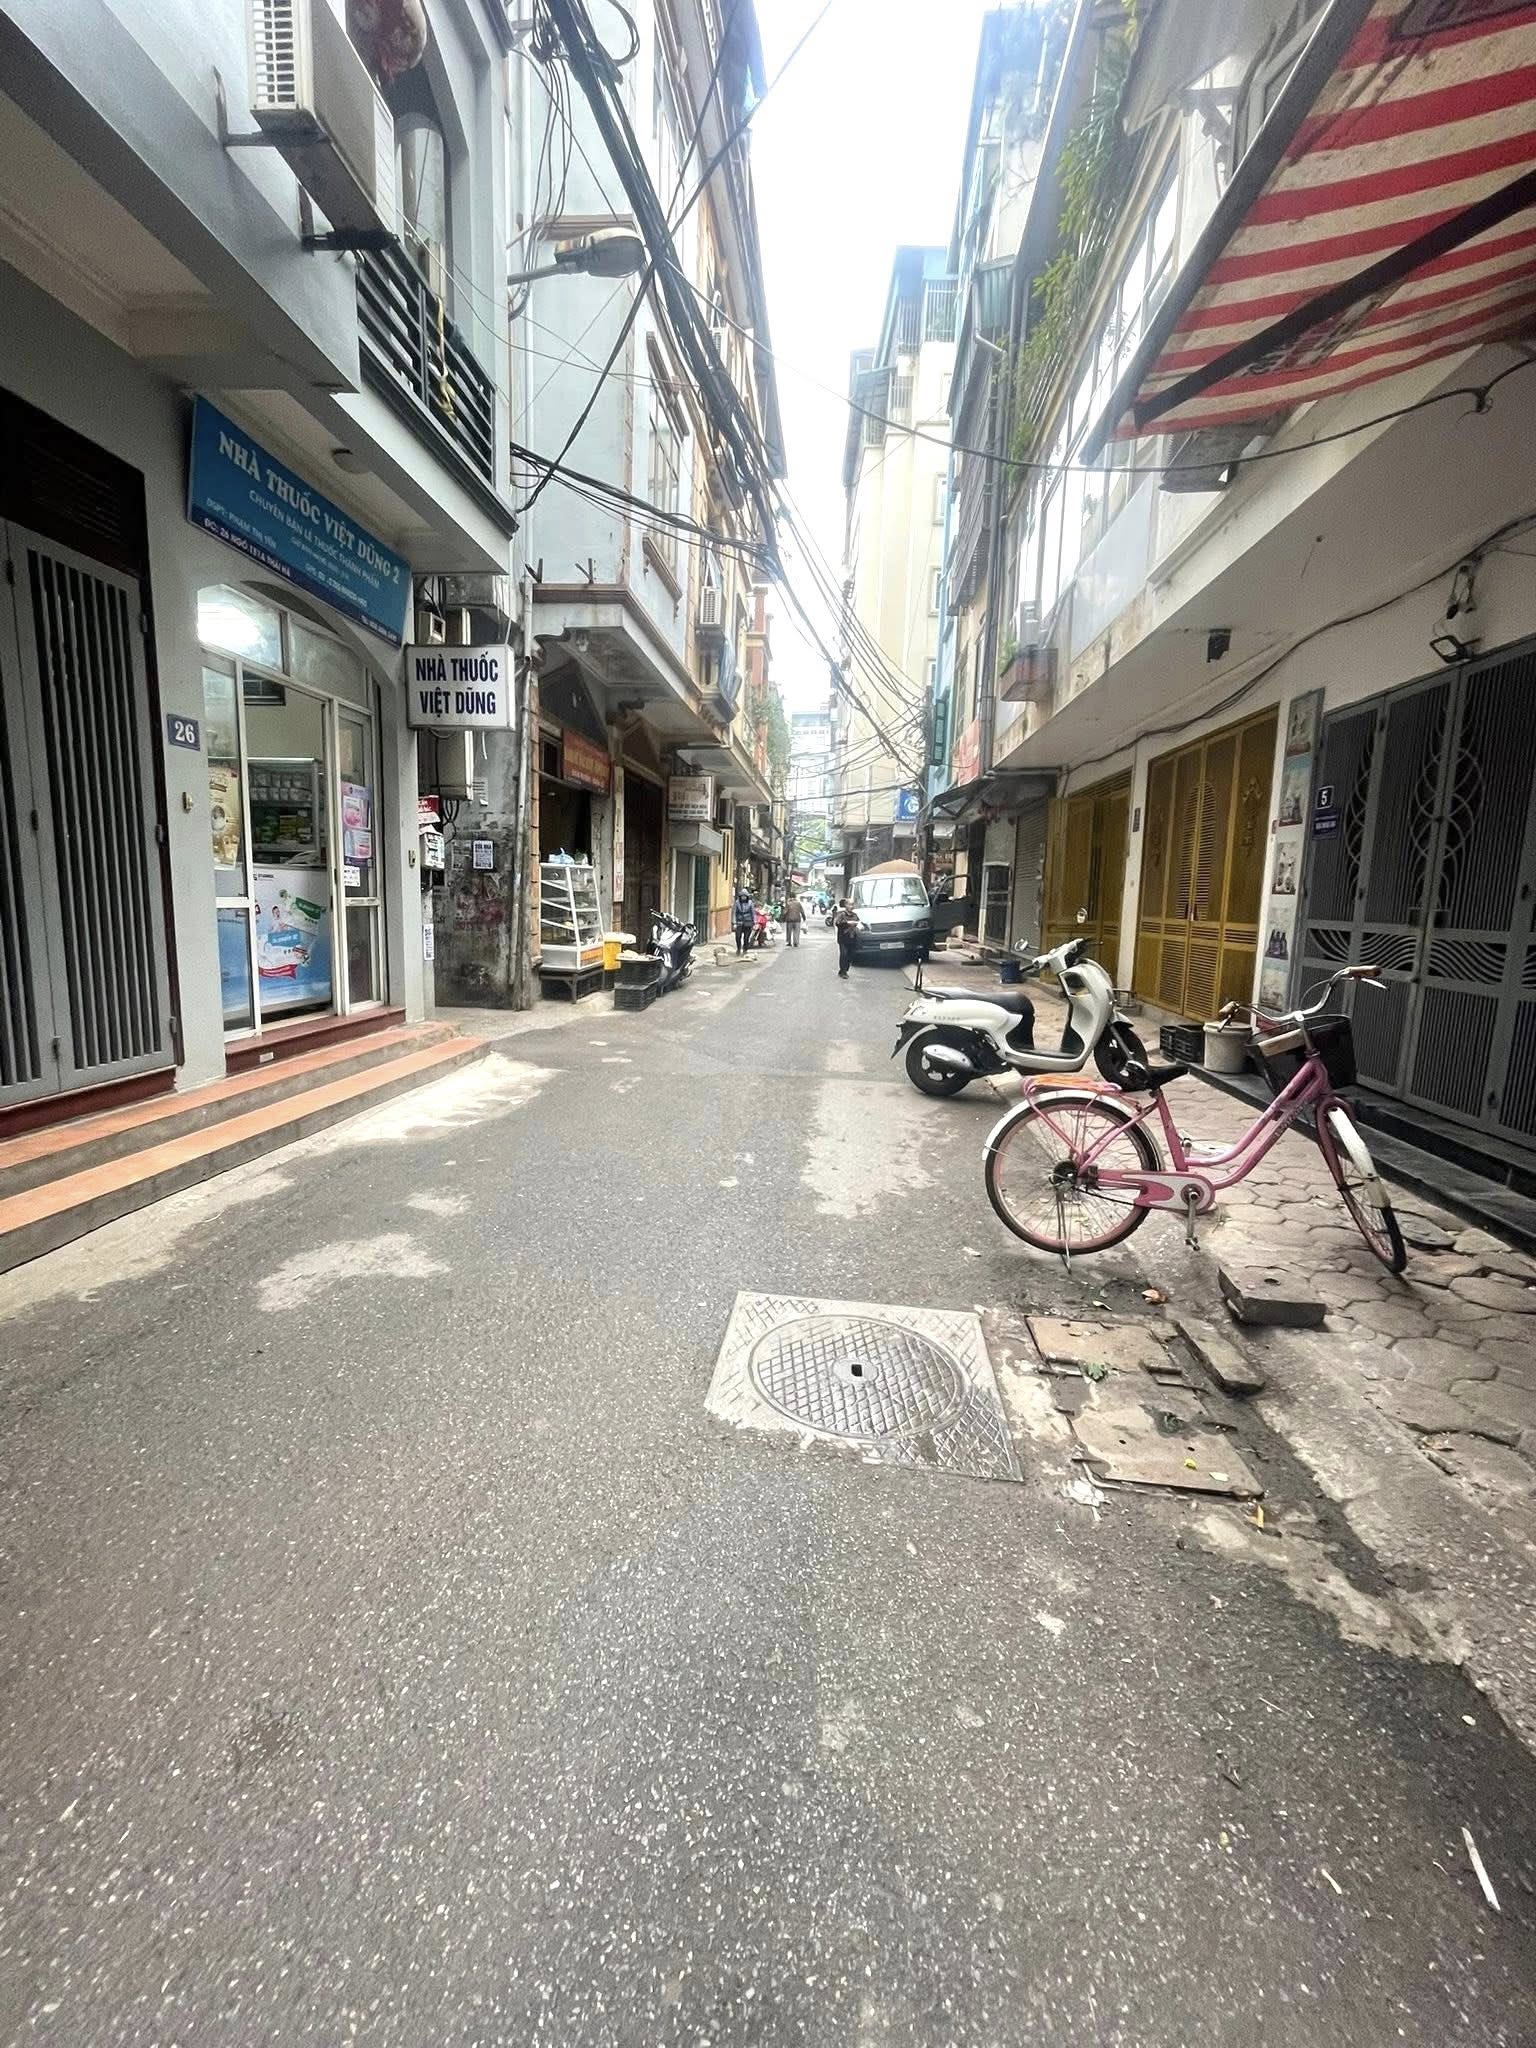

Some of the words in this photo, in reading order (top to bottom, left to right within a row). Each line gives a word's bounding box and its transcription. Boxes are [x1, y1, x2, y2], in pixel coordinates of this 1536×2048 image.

[219, 431, 261, 481] NHÀ
[266, 468, 320, 525] THUỐC
[323, 512, 355, 551] VIỆT
[357, 539, 391, 577] DŨNG
[392, 566, 400, 585] 2
[415, 653, 447, 682] NHÀ
[450, 651, 498, 682] THUỐC
[420, 686, 451, 718] VIỆT
[455, 687, 496, 715] DŨNG
[175, 720, 195, 744] 26
[1321, 790, 1328, 805] 5
